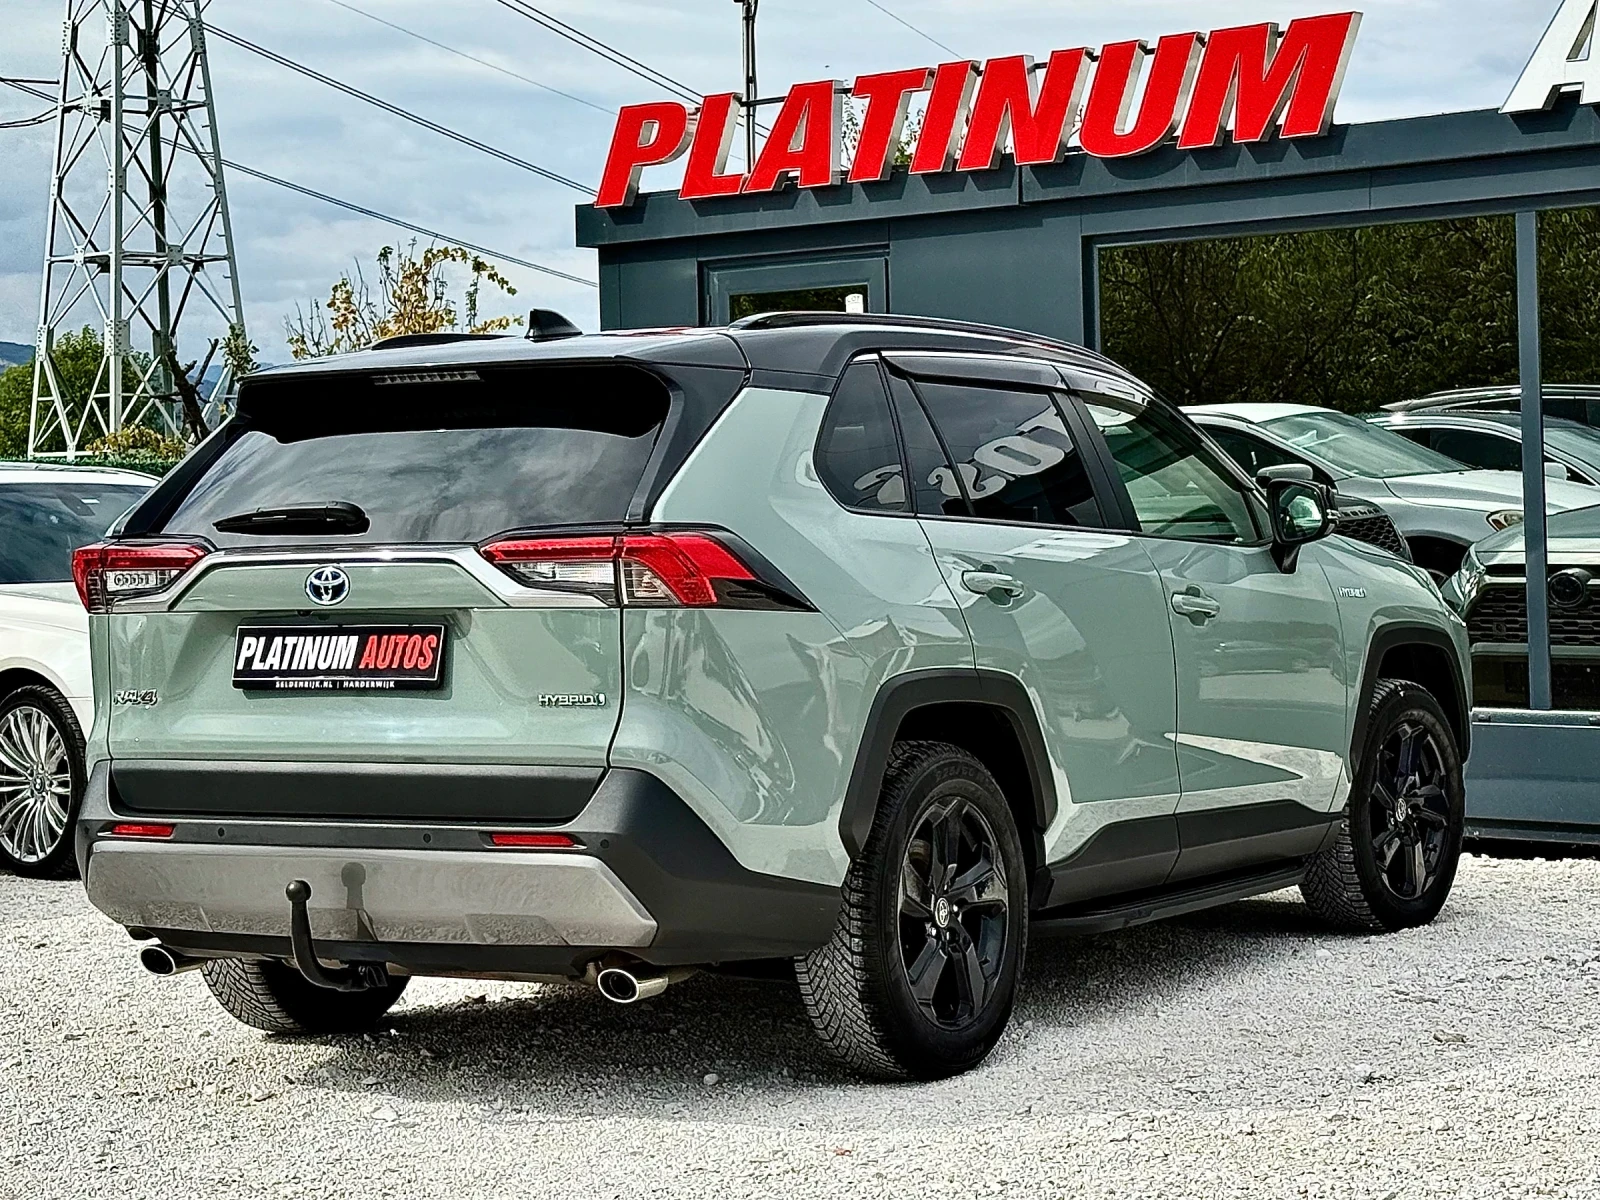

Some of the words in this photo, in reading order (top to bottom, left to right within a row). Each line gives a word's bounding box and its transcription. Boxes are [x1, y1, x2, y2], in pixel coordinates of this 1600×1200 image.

[594, 11, 1362, 209] PLATINUM
[236, 635, 359, 671] PLATINUM
[359, 633, 438, 670] AUTOS
[343, 680, 395, 690] HARDERWIJK
[538, 694, 598, 706] HYBRID
